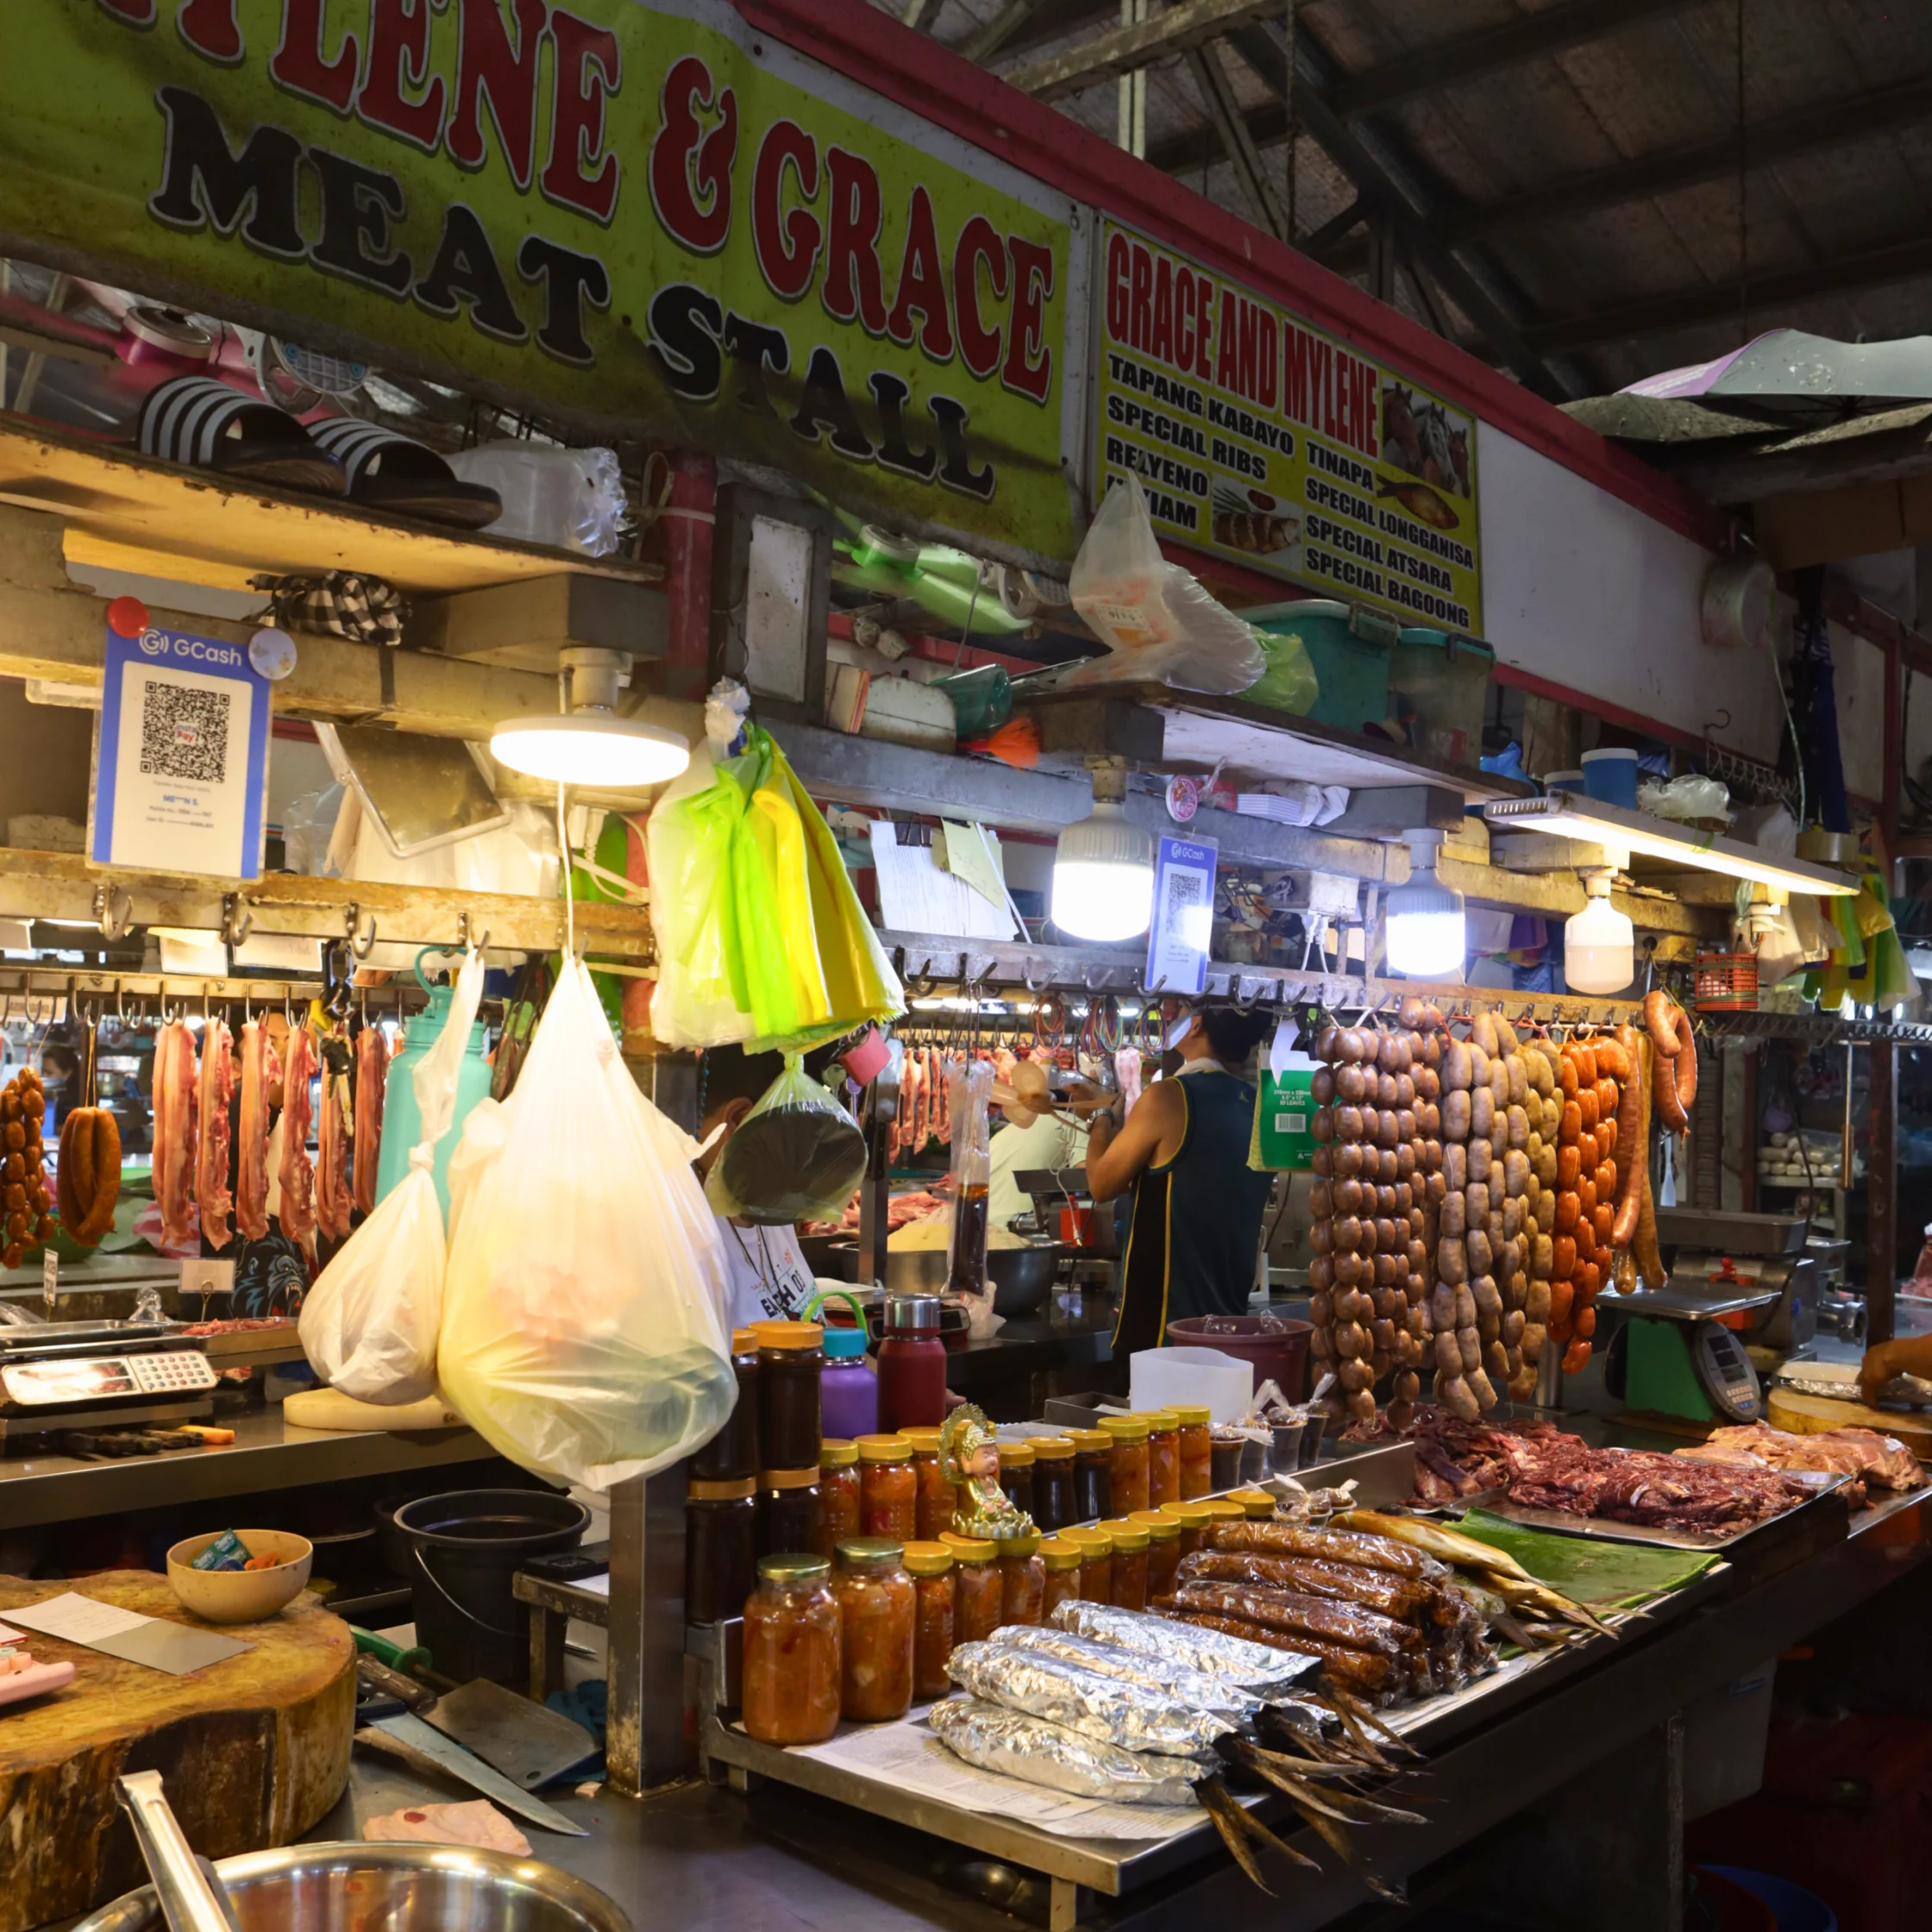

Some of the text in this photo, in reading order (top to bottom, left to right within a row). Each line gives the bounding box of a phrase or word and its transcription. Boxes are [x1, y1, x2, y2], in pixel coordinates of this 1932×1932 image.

[649, 56, 737, 253] &
[752, 118, 1054, 403] GRACE
[147, 86, 995, 499] MEAT STALL
[1107, 232, 1378, 458] GRACE AND MYLENE
[1107, 354, 1294, 456] TAPANG KABAYO
[1107, 395, 1266, 480] SPECIAL RIBS
[1306, 441, 1374, 492] TINAPA
[1306, 479, 1474, 570] SPECIAL LONGGANISA
[1306, 515, 1452, 593] SPECIAL ATSARA
[1306, 549, 1470, 629] SPECIAL BAGOONG
[174, 638, 242, 667] GCash
[1182, 847, 1205, 861] GCash
